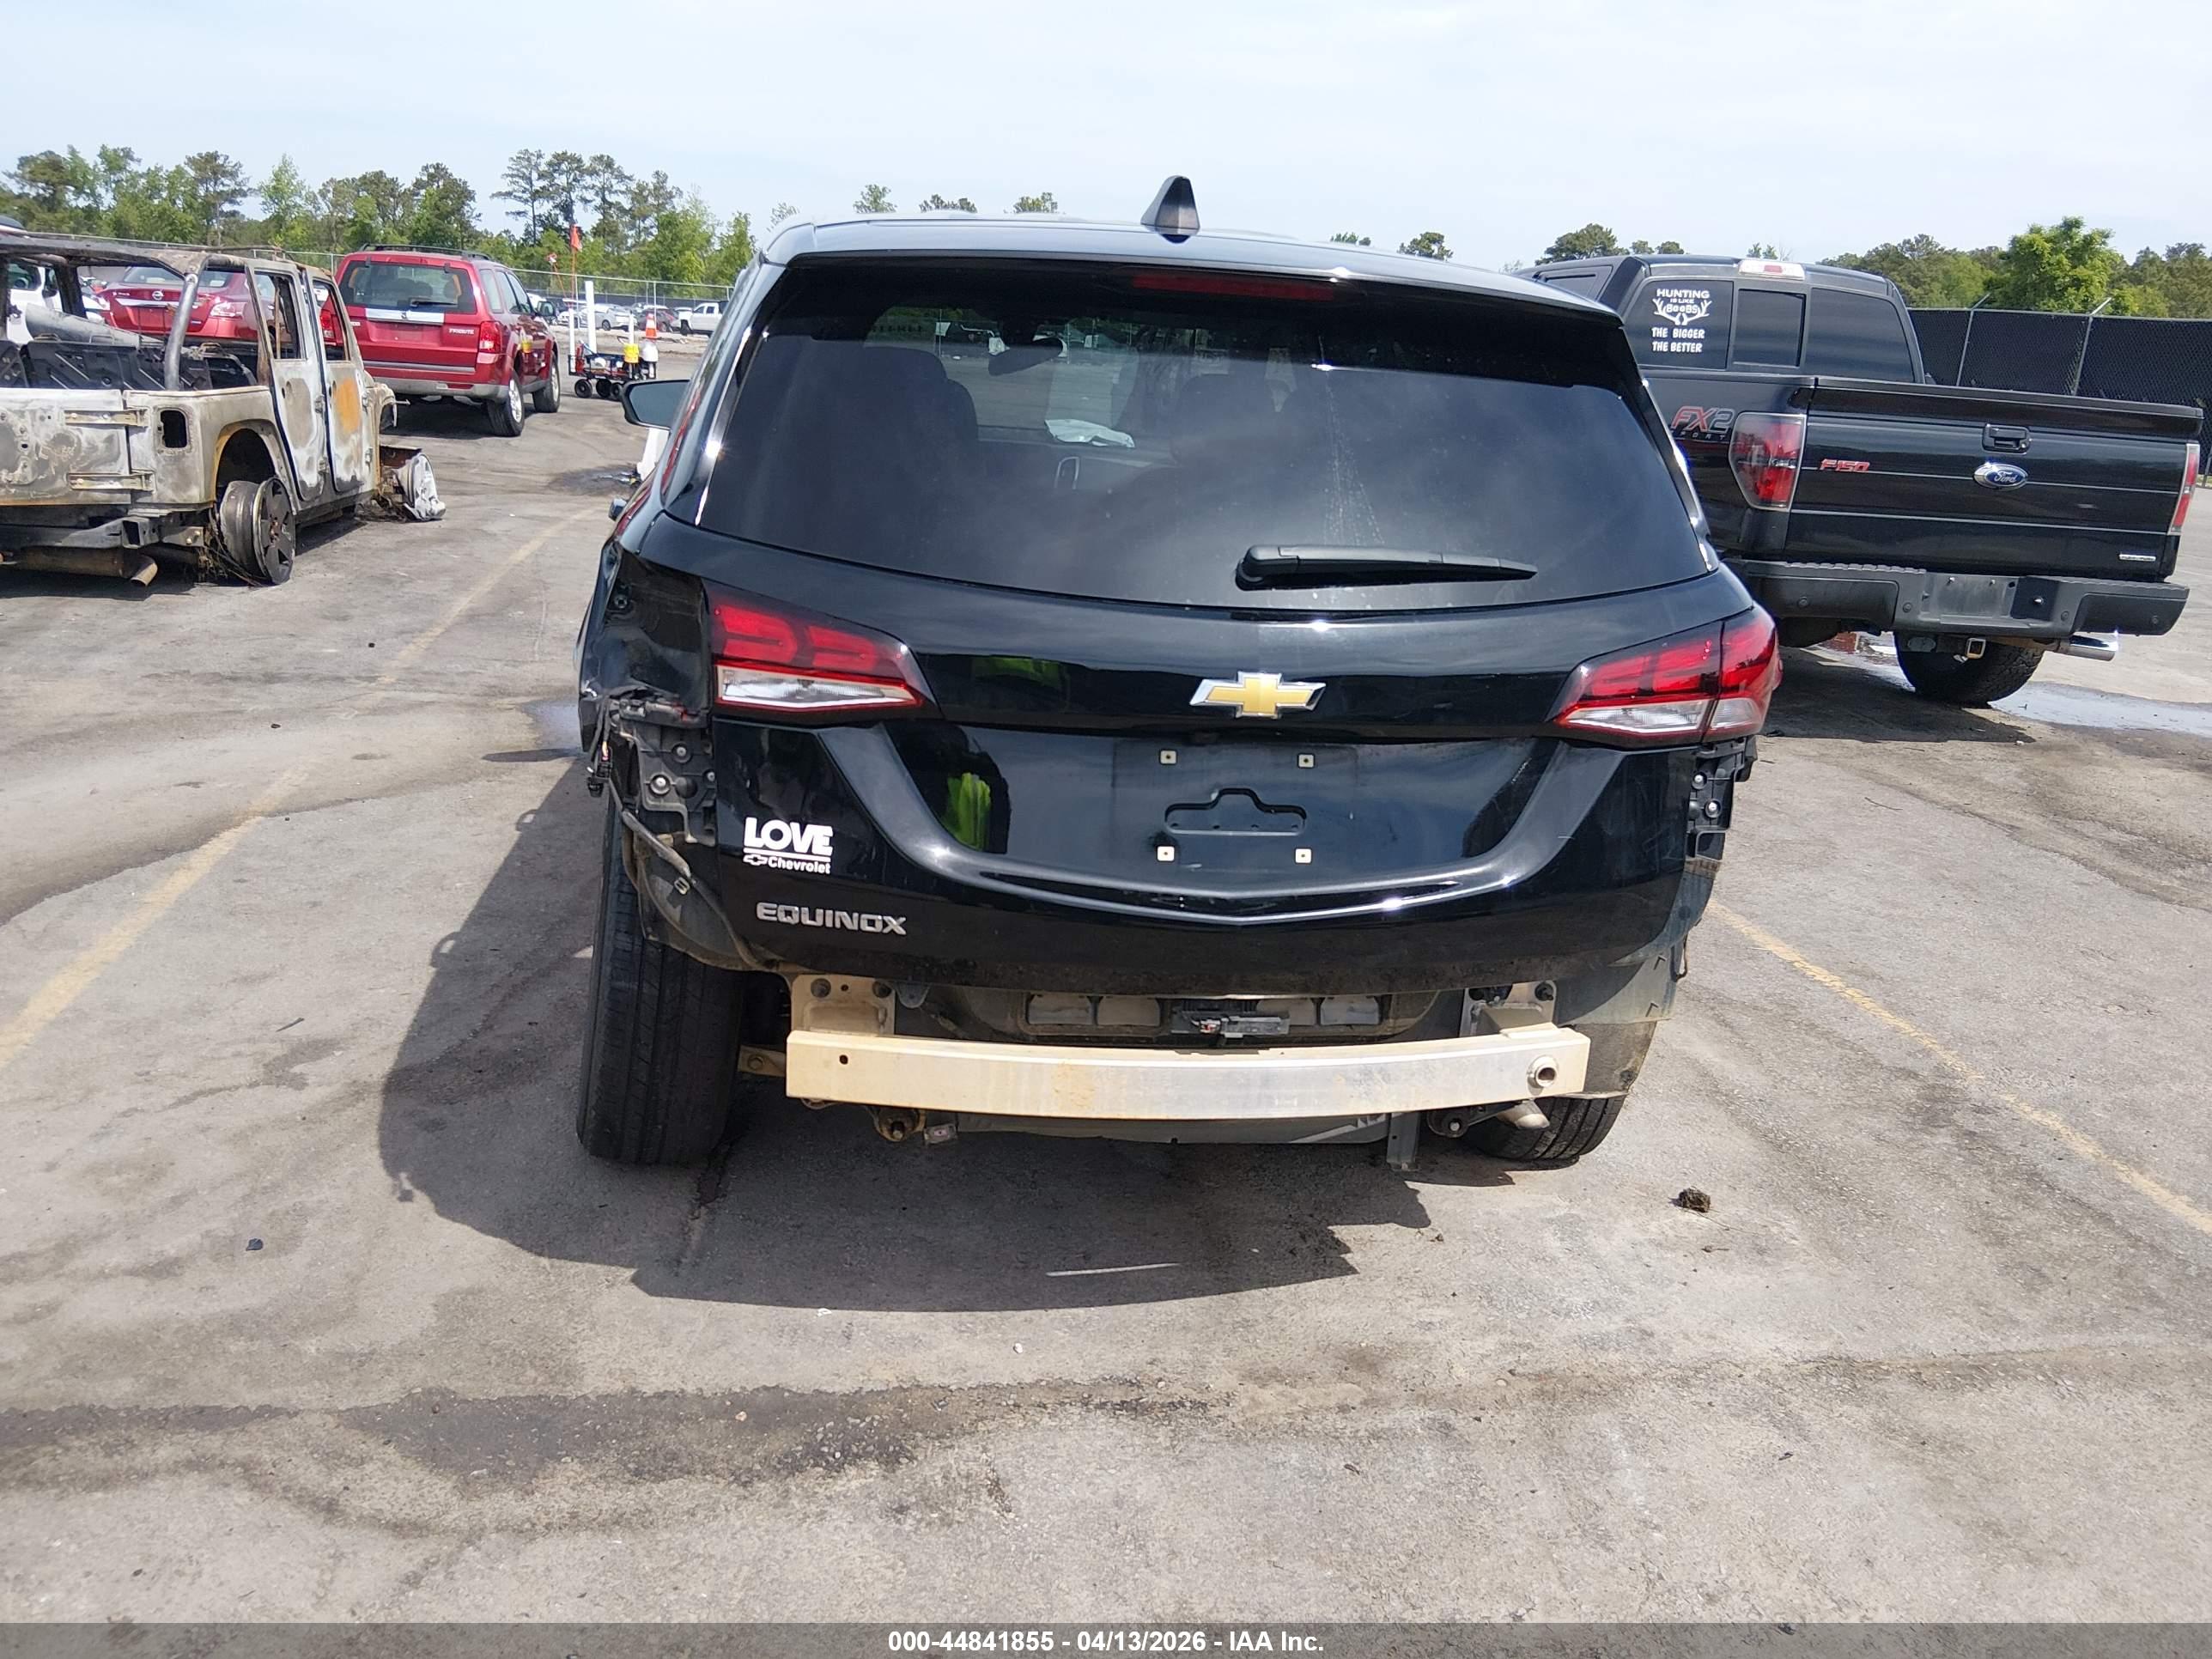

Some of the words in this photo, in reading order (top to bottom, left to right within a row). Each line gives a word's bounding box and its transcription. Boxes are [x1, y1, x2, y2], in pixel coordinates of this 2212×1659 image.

[1656, 289, 1711, 299] HUNTING
[1651, 327, 1668, 337] THE
[1673, 328, 1705, 339] BIGGER
[1652, 341, 1668, 352] THE
[1670, 342, 1703, 353] BETTER
[1670, 405, 1735, 434] FX2
[1993, 471, 2018, 483] Ford
[744, 817, 833, 856] LOVE
[768, 858, 831, 874] Chevrolet
[757, 902, 907, 935] EQUINOX
